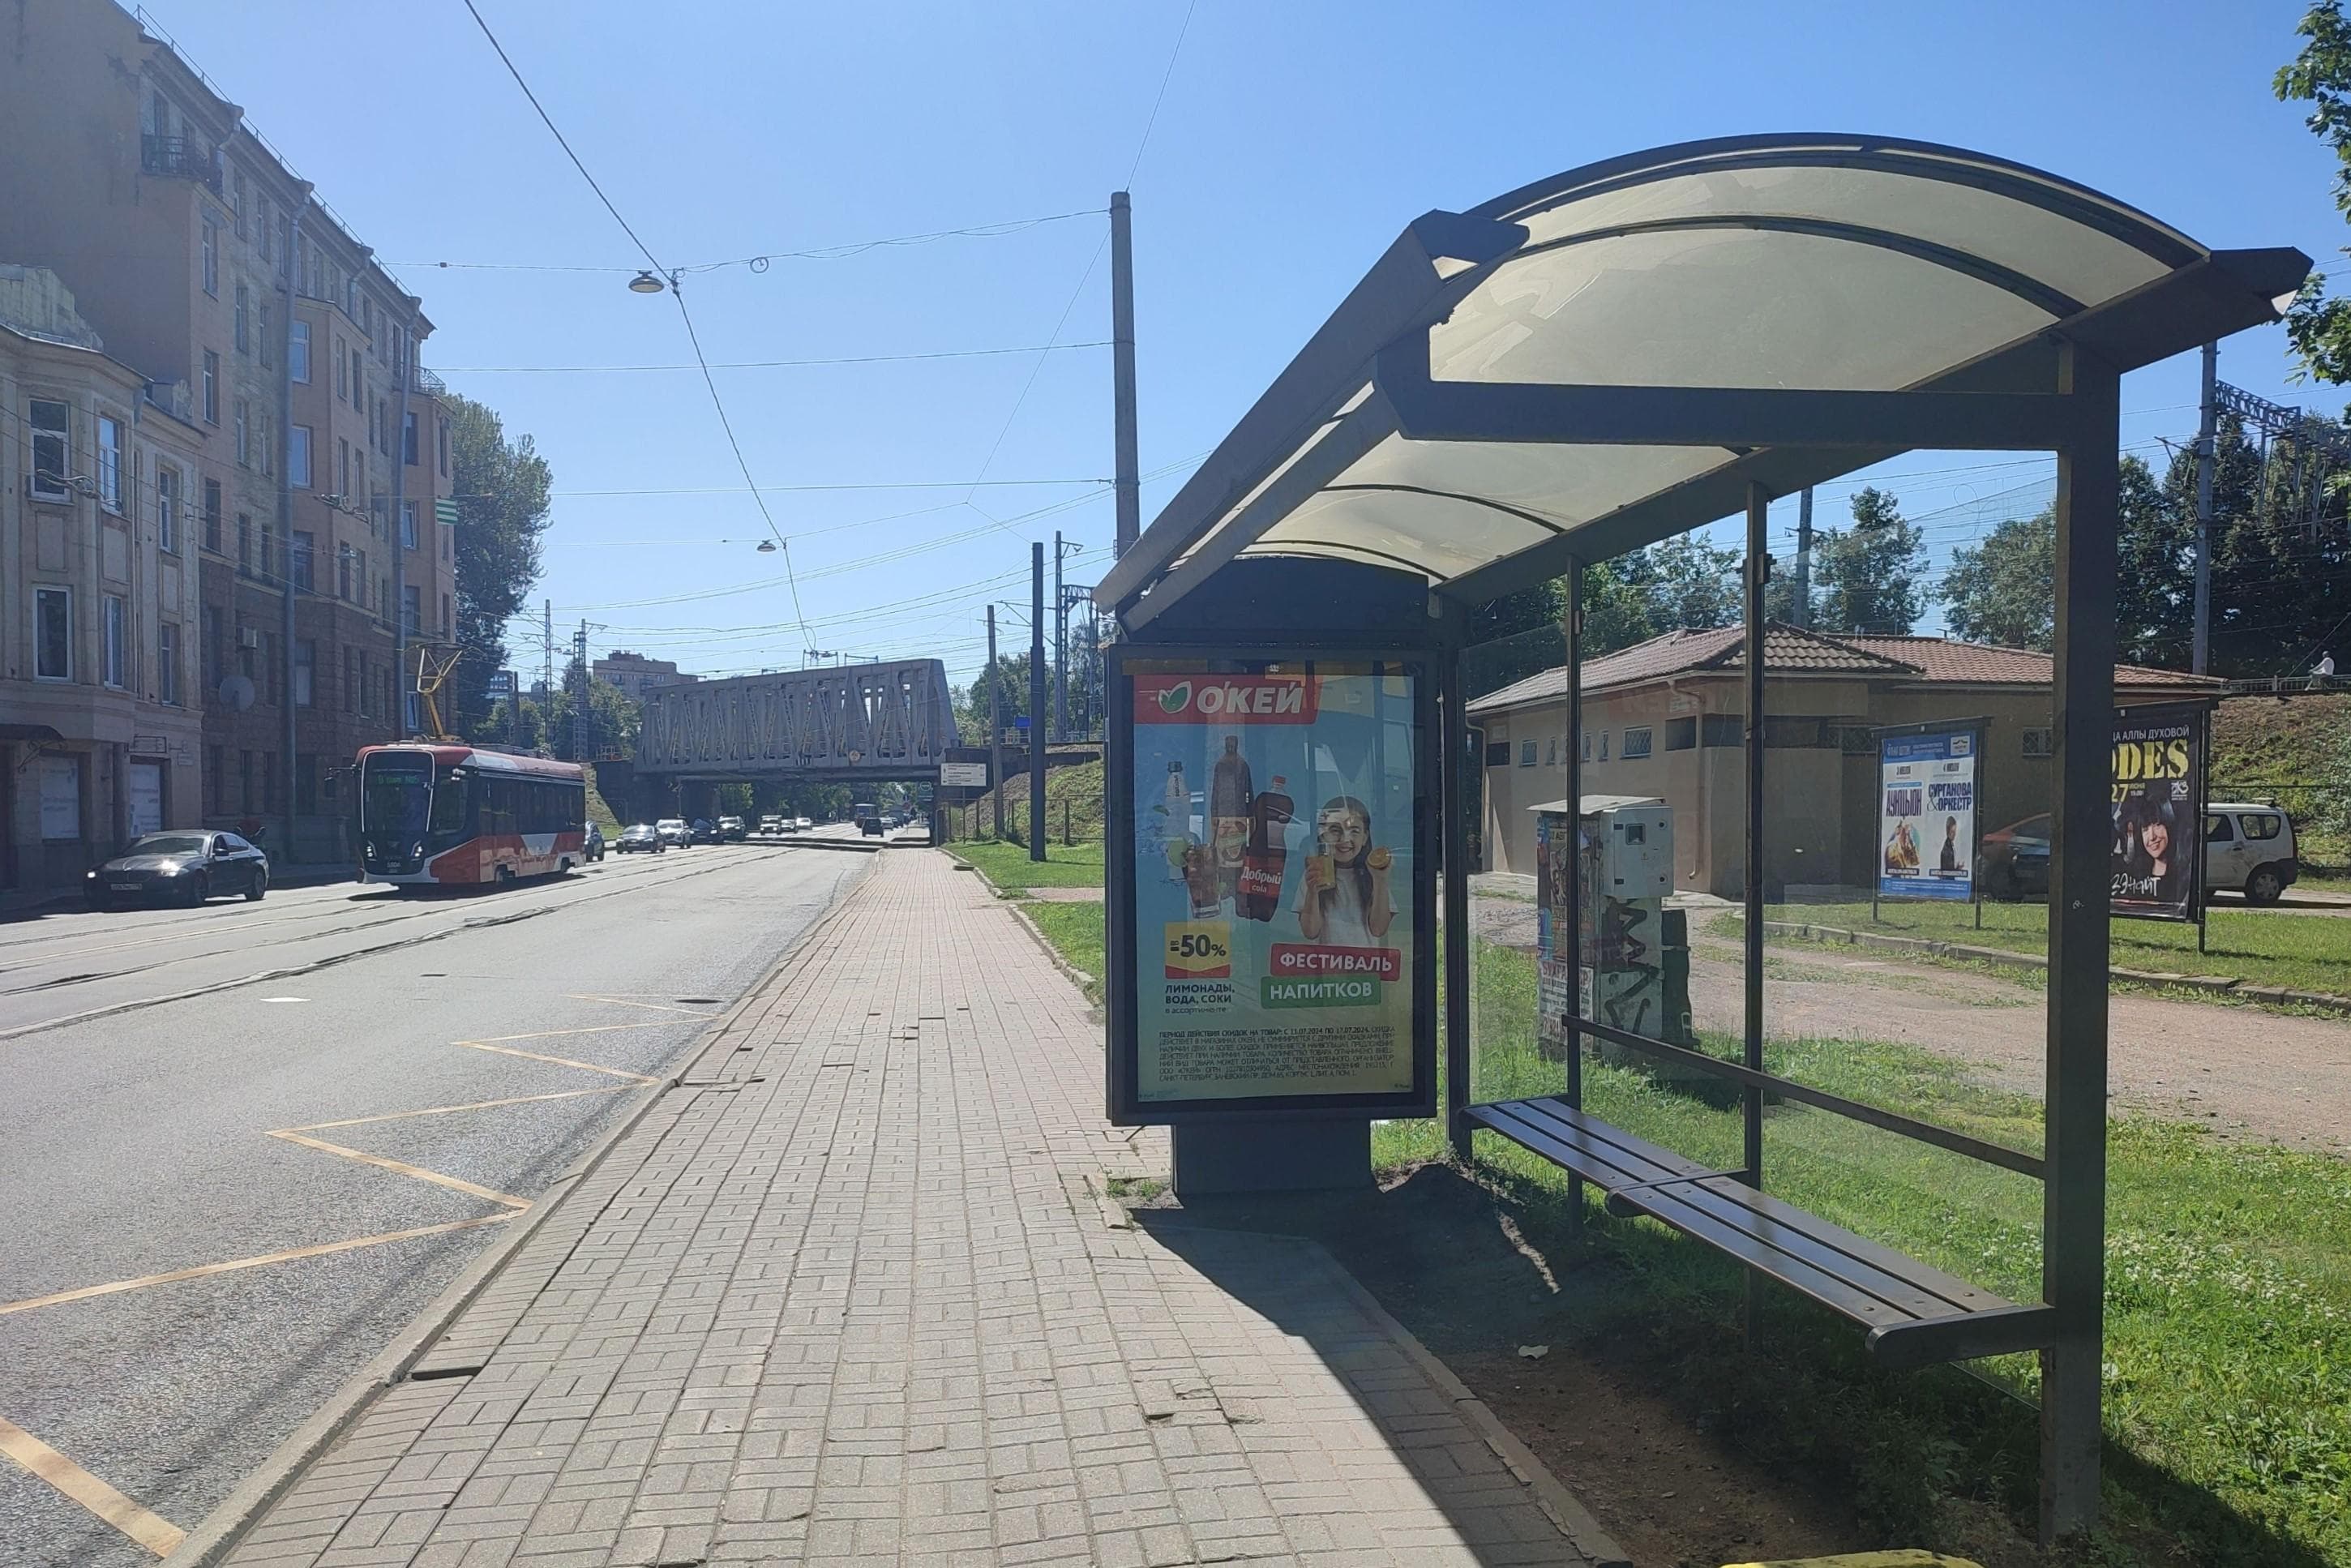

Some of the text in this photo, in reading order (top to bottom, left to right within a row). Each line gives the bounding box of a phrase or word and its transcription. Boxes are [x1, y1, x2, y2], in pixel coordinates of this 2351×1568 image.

[2122, 730, 2146, 740] АЛЛЫ
[2148, 724, 2190, 740] ДУХОВОЙ
[1929, 782, 1972, 798] СУРГАНОВА
[2111, 783, 2129, 803] 27
[1240, 866, 1282, 885] Добрый
[1252, 884, 1267, 893] cola
[1279, 952, 1393, 973] ФЕСТИВАЛЬ
[1165, 983, 1235, 993] ЛИМОНАДЫ,
[1270, 982, 1373, 1000] НАПИТКОВ
[1165, 994, 1231, 1005] ВОДА, СОКИ
